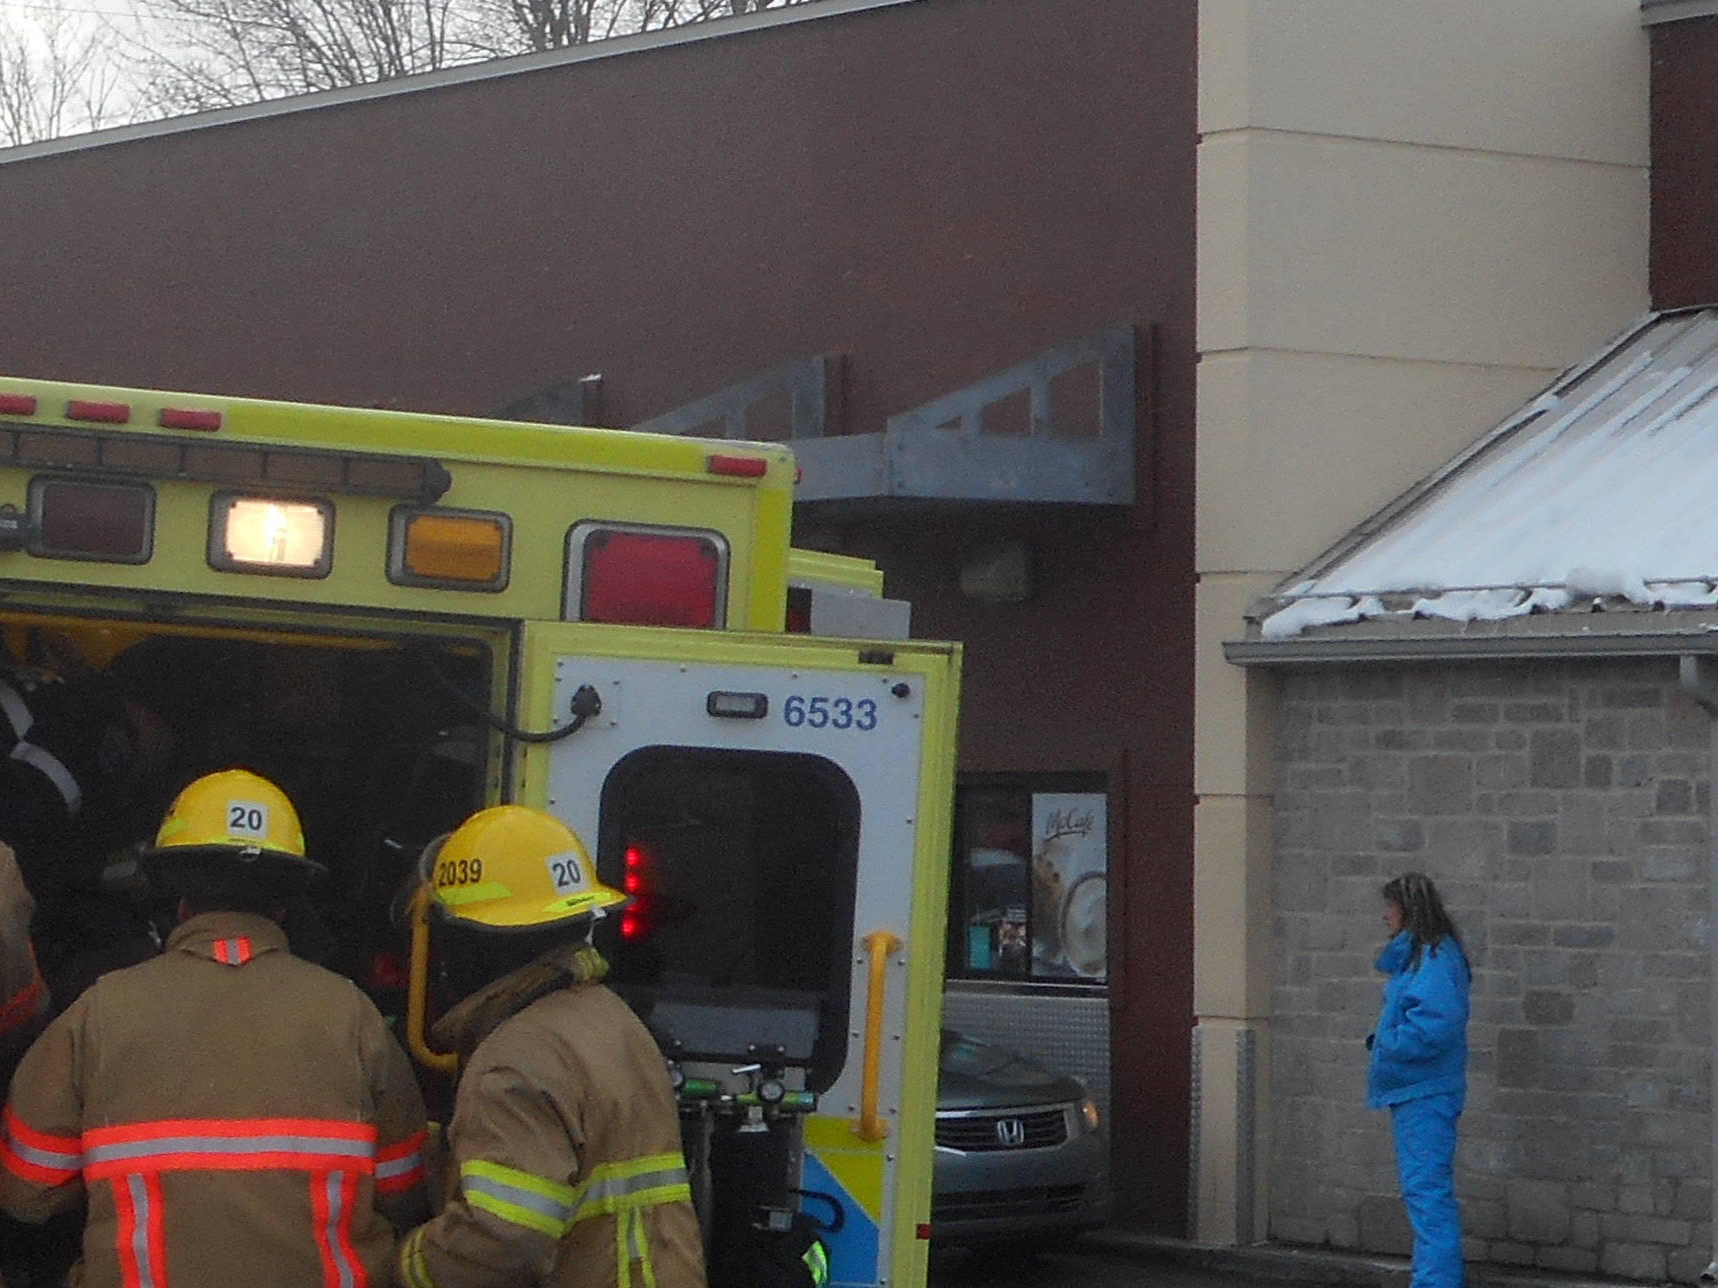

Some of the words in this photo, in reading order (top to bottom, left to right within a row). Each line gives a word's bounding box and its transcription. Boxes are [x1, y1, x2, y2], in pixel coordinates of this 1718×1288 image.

[784, 695, 878, 731] 6533
[230, 806, 262, 830] 20
[438, 858, 482, 886] 2039
[553, 859, 581, 887] 20
